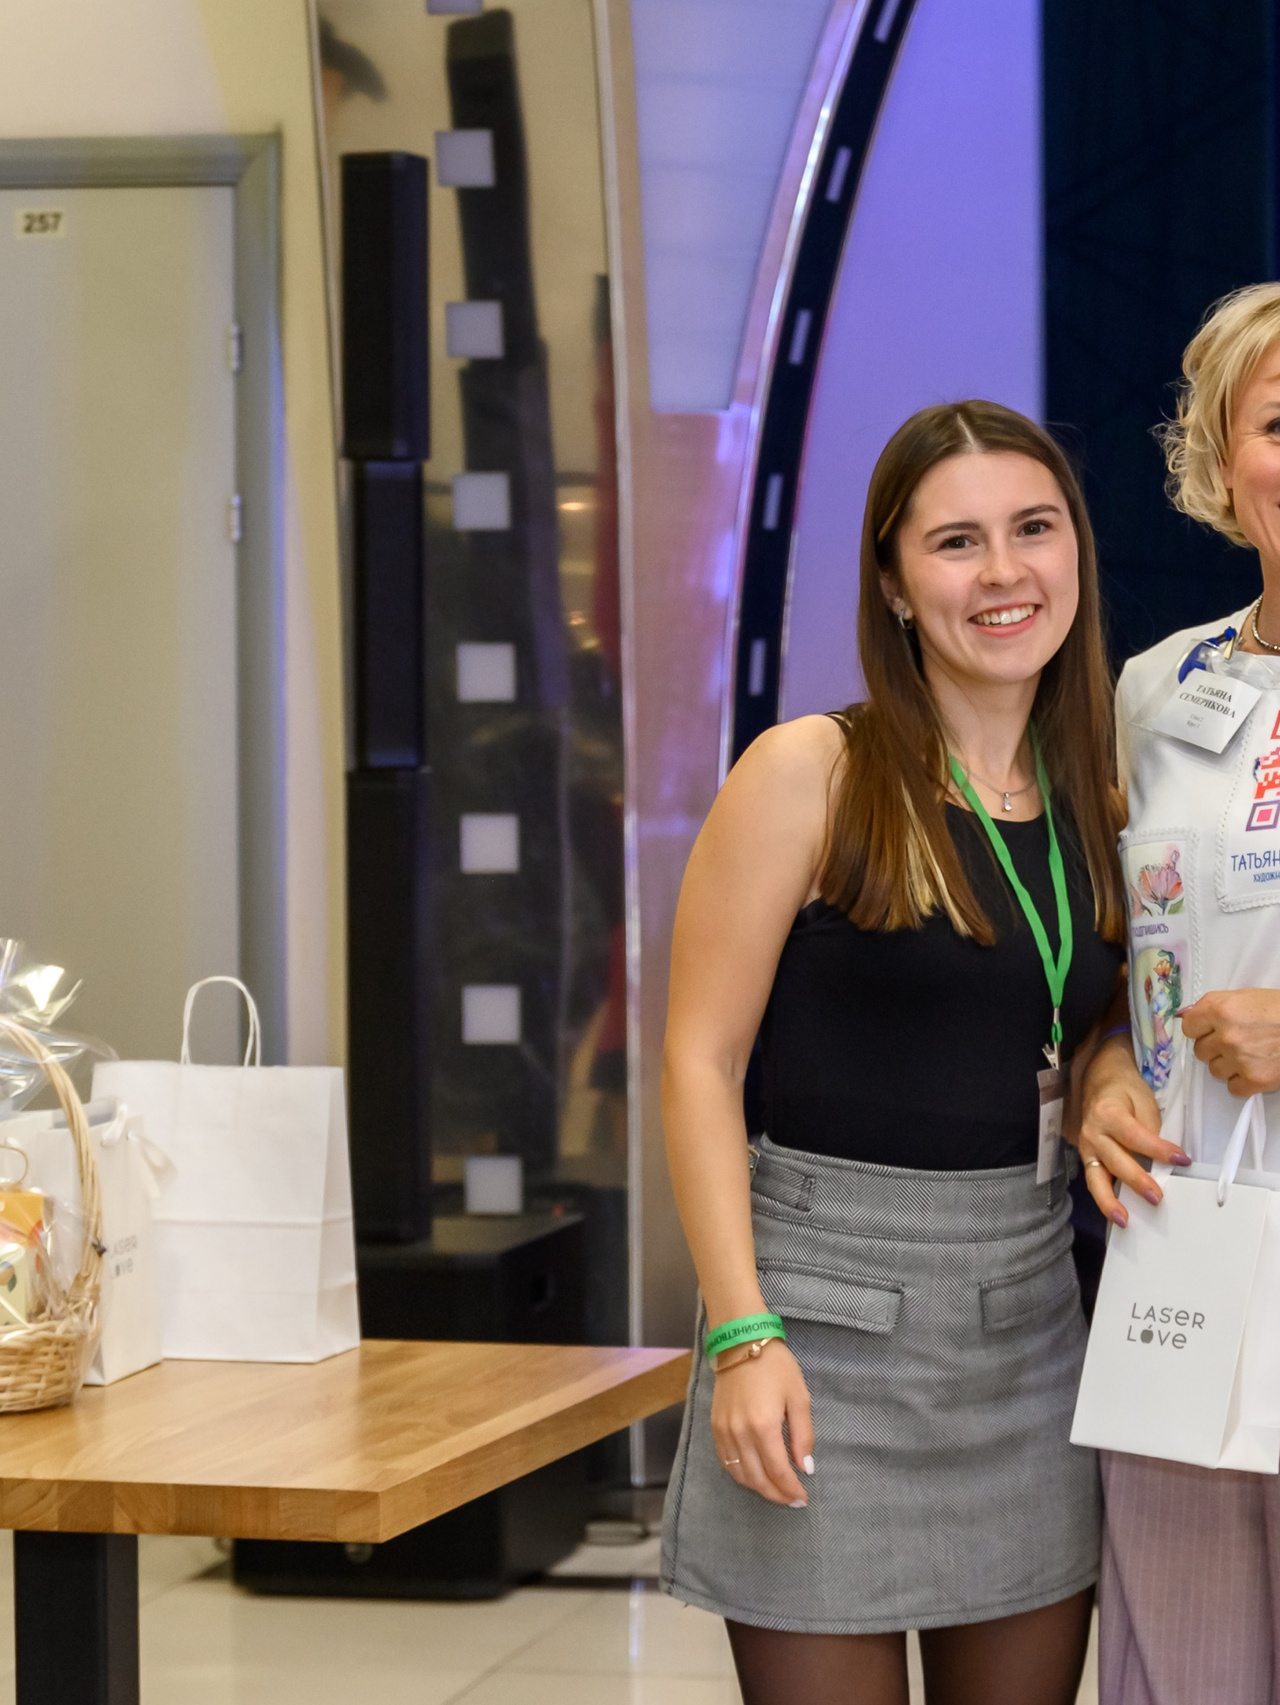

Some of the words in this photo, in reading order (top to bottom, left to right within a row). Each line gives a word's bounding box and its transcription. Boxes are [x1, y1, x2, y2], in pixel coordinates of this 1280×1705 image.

[23, 212, 62, 233] 257
[1196, 684, 1232, 703] ТАТЬЯНА
[1179, 692, 1235, 718] СЕМЕРИКОВА
